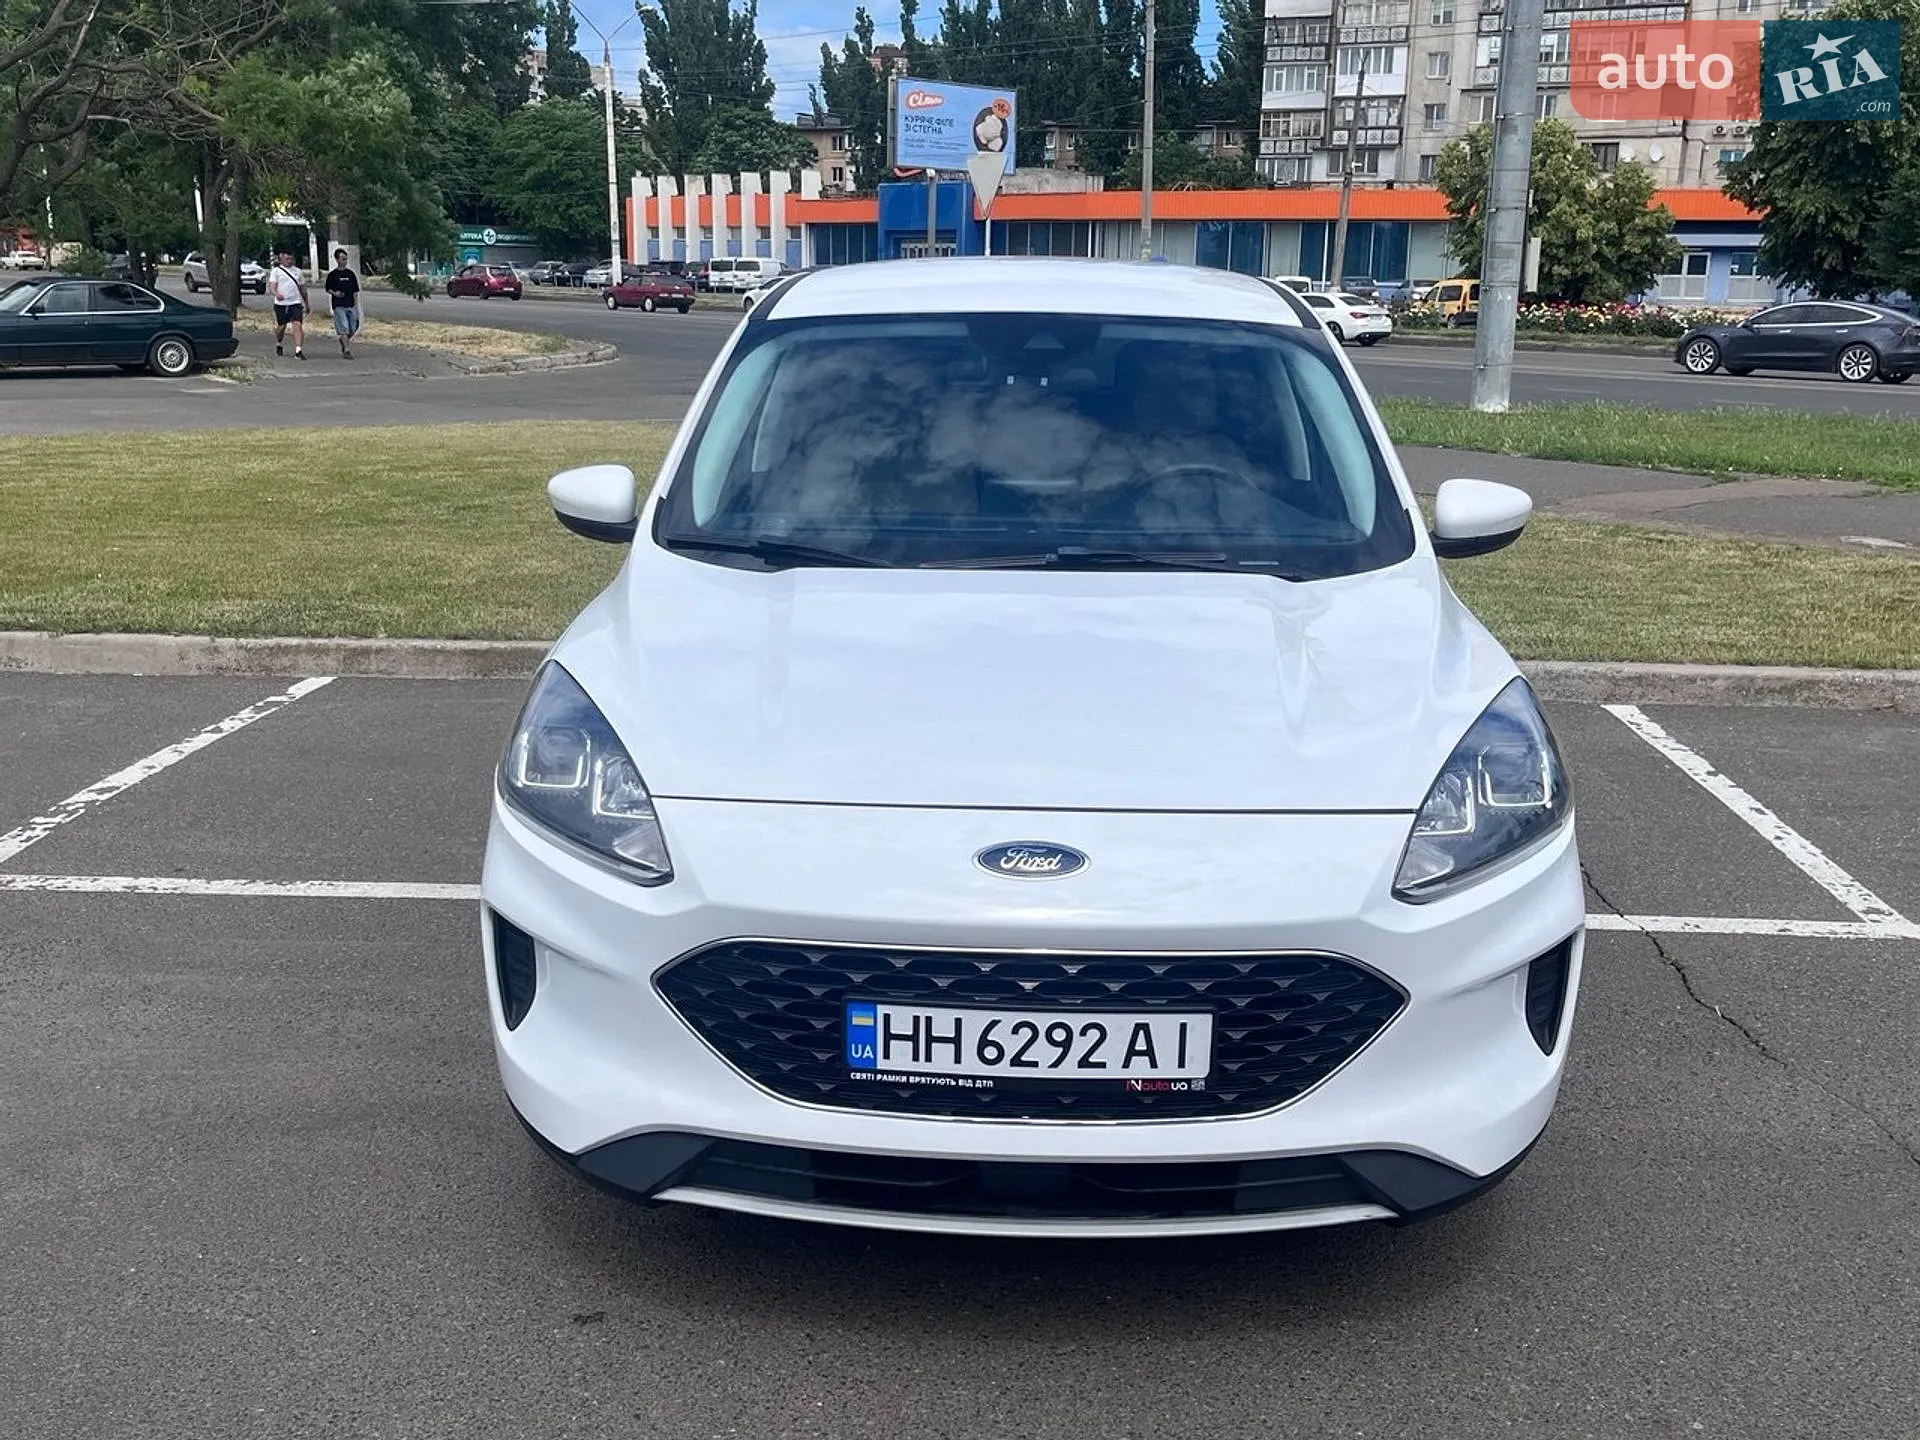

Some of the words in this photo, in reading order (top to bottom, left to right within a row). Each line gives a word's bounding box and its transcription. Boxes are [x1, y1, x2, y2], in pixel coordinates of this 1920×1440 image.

[912, 125, 943, 135] СТЕГНА
[1000, 847, 1063, 871] Ford
[882, 1012, 963, 1065] HH
[976, 1019, 1108, 1070] 6292
[1121, 1021, 1188, 1070] AI
[851, 1044, 874, 1060] UA
[850, 1072, 874, 1081] СВЯТІ
[876, 1074, 907, 1083] РАМКИ
[909, 1076, 956, 1087] ВРЯТУЮТЬ
[958, 1078, 973, 1087] ВІД
[975, 1080, 994, 1089] ДТП
